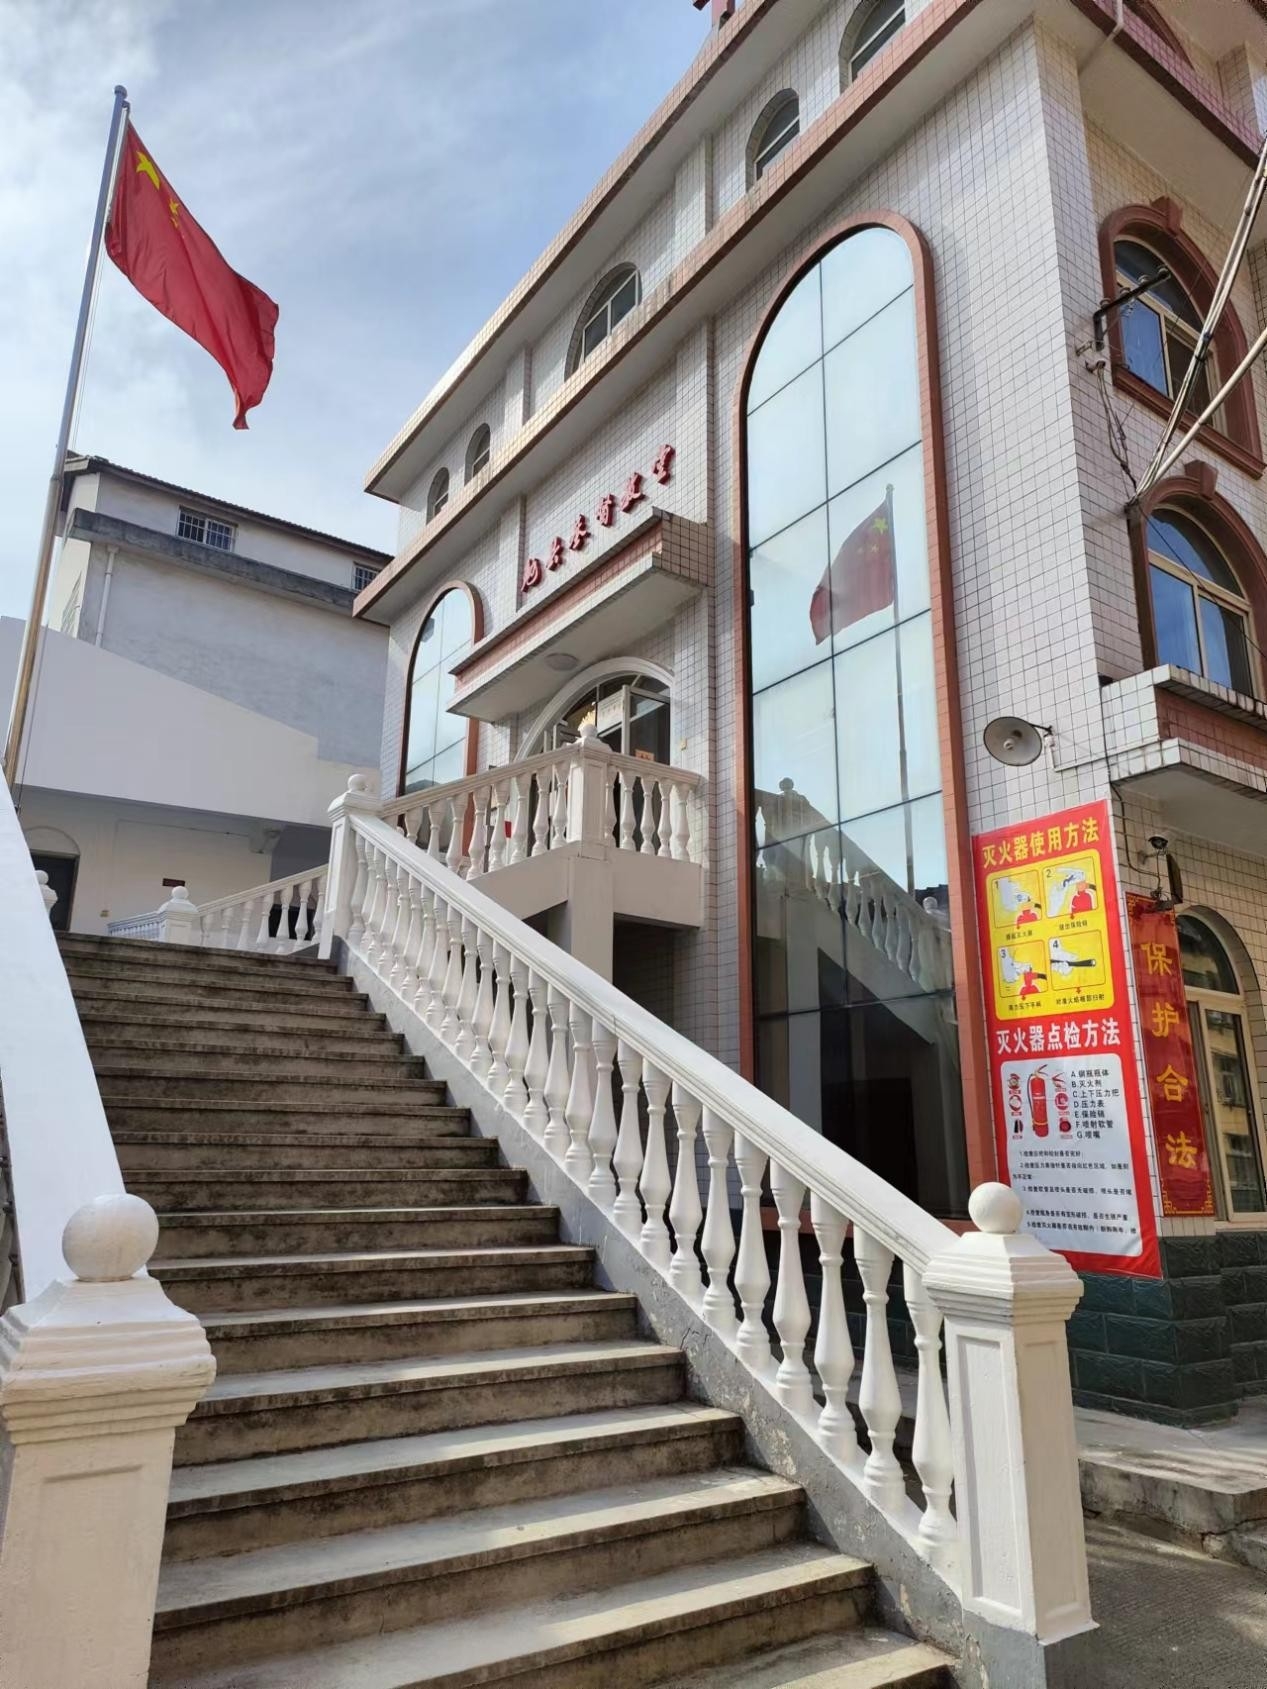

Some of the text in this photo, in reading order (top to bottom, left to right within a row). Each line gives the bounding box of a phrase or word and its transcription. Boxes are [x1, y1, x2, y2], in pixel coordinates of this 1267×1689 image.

[982, 817, 1099, 868] 灭火器使用方法
[1046, 869, 1051, 878] 2
[1052, 940, 1059, 948] 4
[1001, 949, 1006, 958] 3
[996, 1017, 1120, 1055] 灭火器点检方法
[1140, 942, 1197, 1169] 保护合法
[1074, 1100, 1105, 1108] D.压力表
